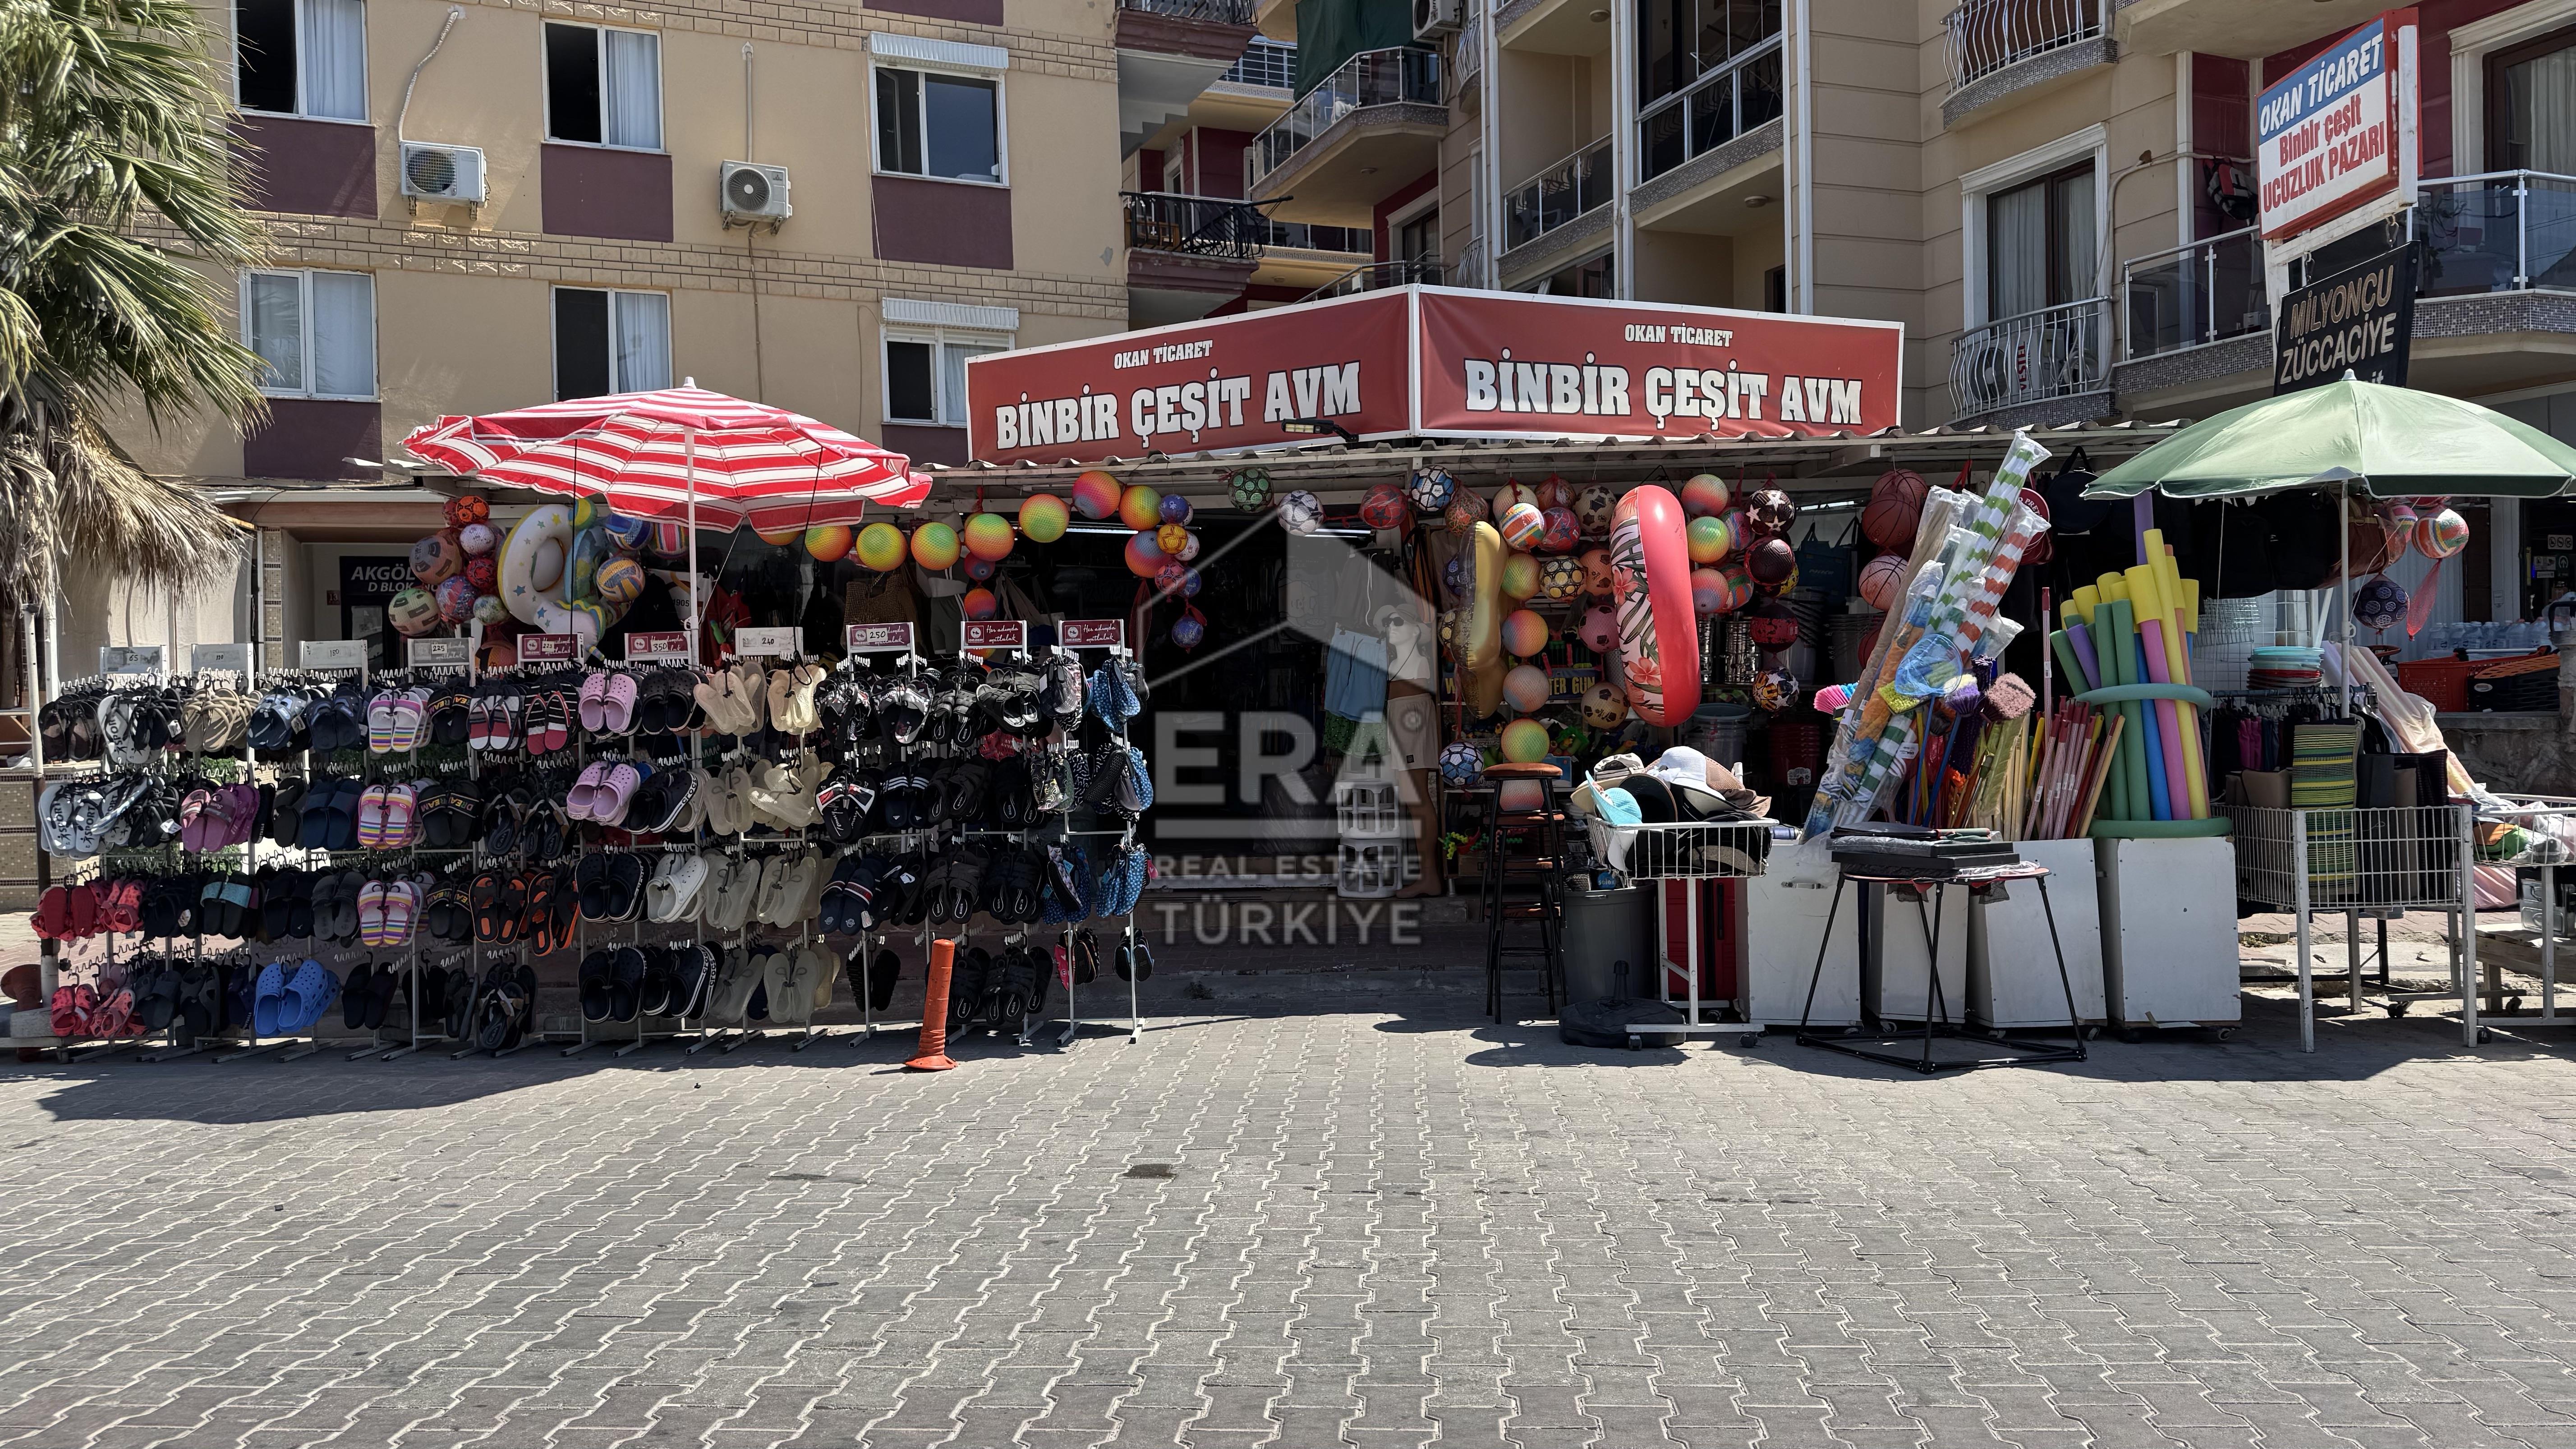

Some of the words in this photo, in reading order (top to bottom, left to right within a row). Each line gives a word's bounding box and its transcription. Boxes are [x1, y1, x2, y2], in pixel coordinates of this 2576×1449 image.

[2260, 83, 2303, 136] OKAN
[2309, 33, 2383, 107] TİCARET
[2263, 153, 2325, 213] UCUZLUK
[2328, 121, 2385, 180] PAZARI
[2291, 265, 2393, 339] MİLYONCU
[1624, 324, 1666, 344] OKAN
[1670, 321, 1733, 348] TİCARET
[1113, 349, 1149, 370] OKAN
[1153, 340, 1213, 363] TİCARET
[2280, 313, 2397, 385] ZÜCCACİYE
[1464, 346, 1632, 416] BİNBİR
[1645, 359, 1769, 430] ÇEŞİT
[1780, 375, 1863, 426] AVM
[996, 383, 1120, 450] BİNBİR
[1131, 367, 1252, 449] ÇEŞİT
[1264, 361, 1362, 423] AVM
[351, 563, 415, 580] AKGÖL
[368, 582, 377, 592] D
[380, 582, 414, 592] BLOK
[653, 643, 667, 652] 350
[762, 637, 774, 645] 240
[1572, 676, 1595, 695] GUN
[429, 699, 450, 714] REAM
[110, 720, 122, 749] SPOR
[420, 796, 446, 811] REAM
[450, 797, 474, 810] DREA
[682, 776, 698, 804] crocs
